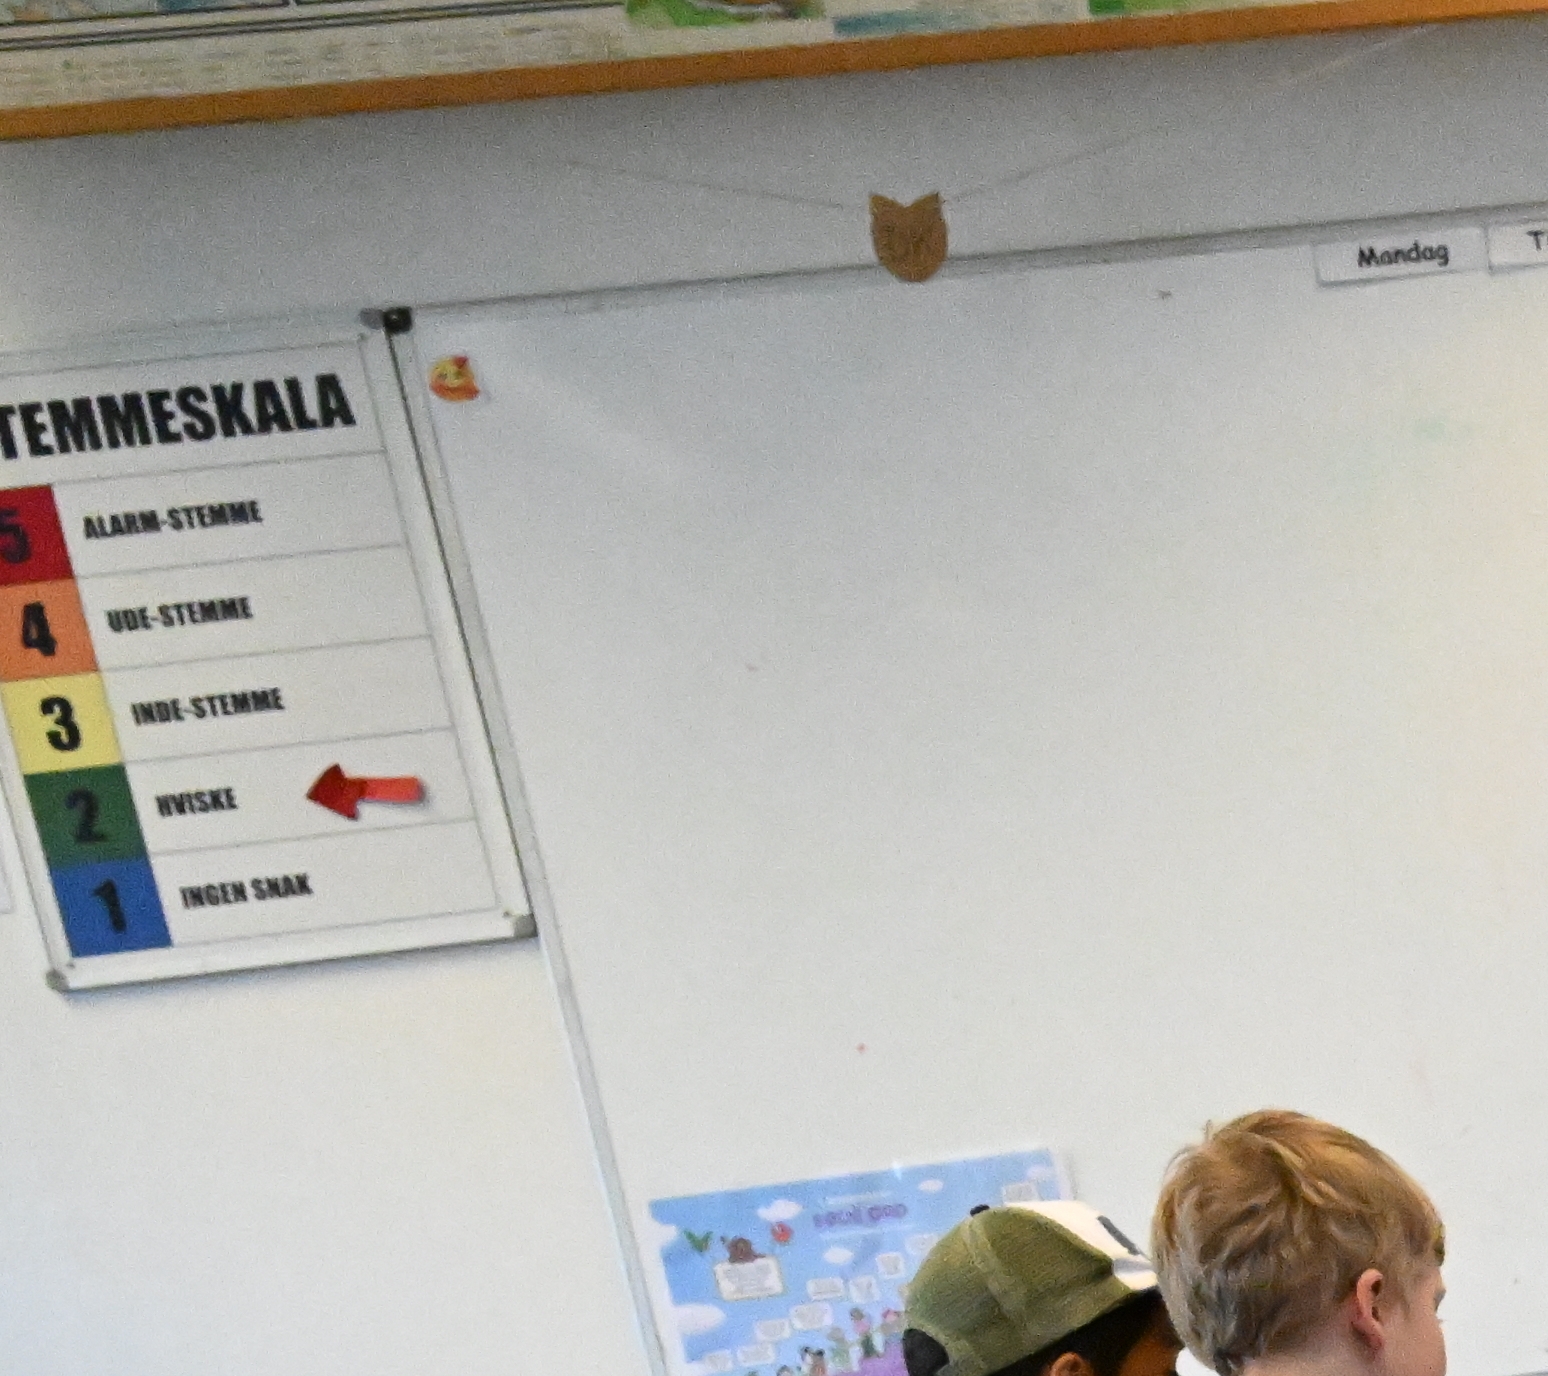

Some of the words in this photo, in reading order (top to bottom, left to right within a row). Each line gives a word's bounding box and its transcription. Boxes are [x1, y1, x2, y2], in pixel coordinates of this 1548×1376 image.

[1357, 239, 1450, 269] Mandag
[0, 508, 32, 564] 5
[82, 499, 264, 540] ALARM-STEMME
[20, 602, 58, 658] 4
[106, 597, 254, 634] UDE-STEMME
[40, 696, 83, 753] 3
[130, 687, 286, 727] INDE-STEMME
[63, 787, 104, 845] 2
[155, 786, 239, 820] HVISKE
[89, 880, 128, 934] 1
[178, 877, 247, 911] INGEN
[250, 871, 314, 904] SNAK
